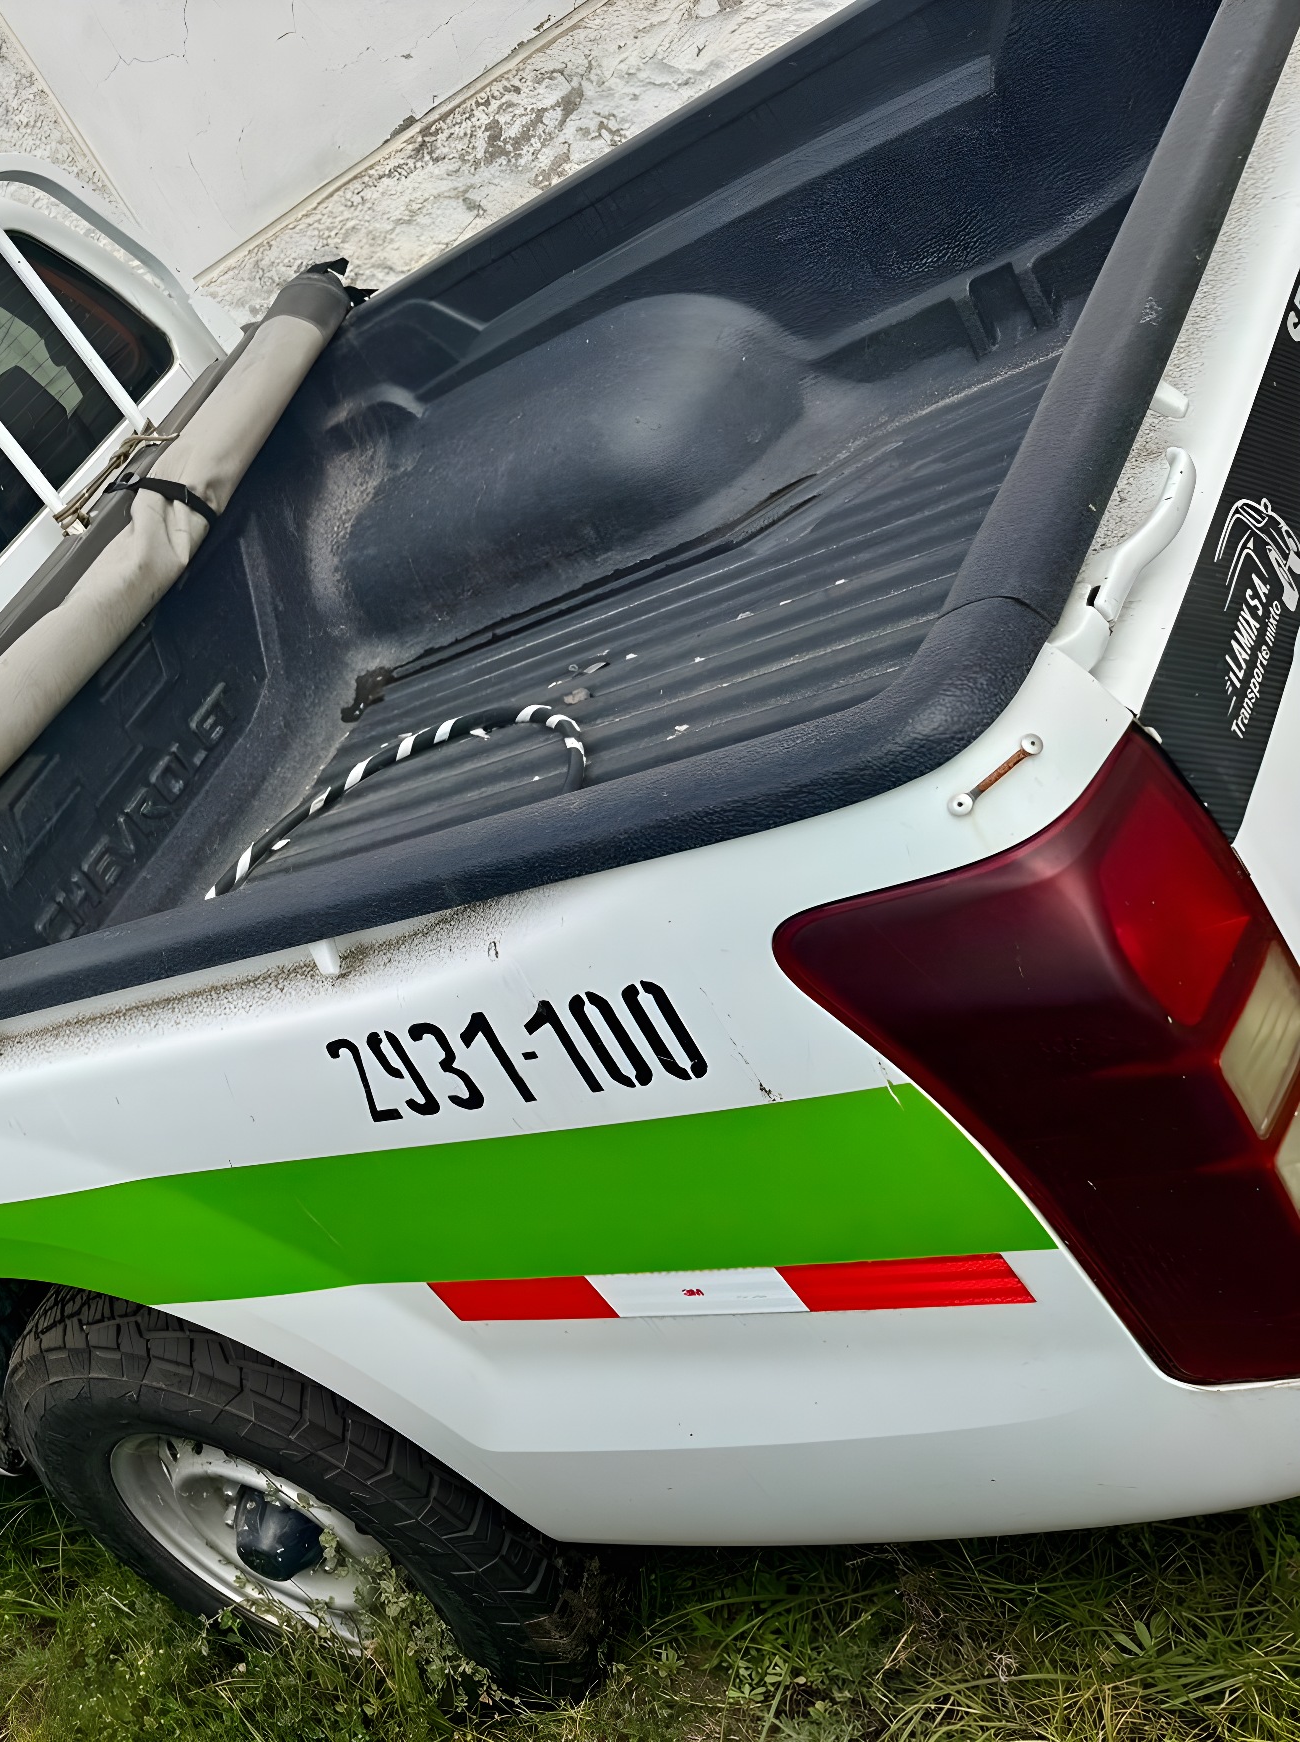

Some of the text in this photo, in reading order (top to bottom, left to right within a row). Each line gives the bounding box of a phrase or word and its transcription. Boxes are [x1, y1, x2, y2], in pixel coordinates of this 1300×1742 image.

[1230, 600, 1282, 739] Transporte mixto
[33, 680, 234, 942] CHEVROLET
[325, 979, 709, 1123] 2931-100
